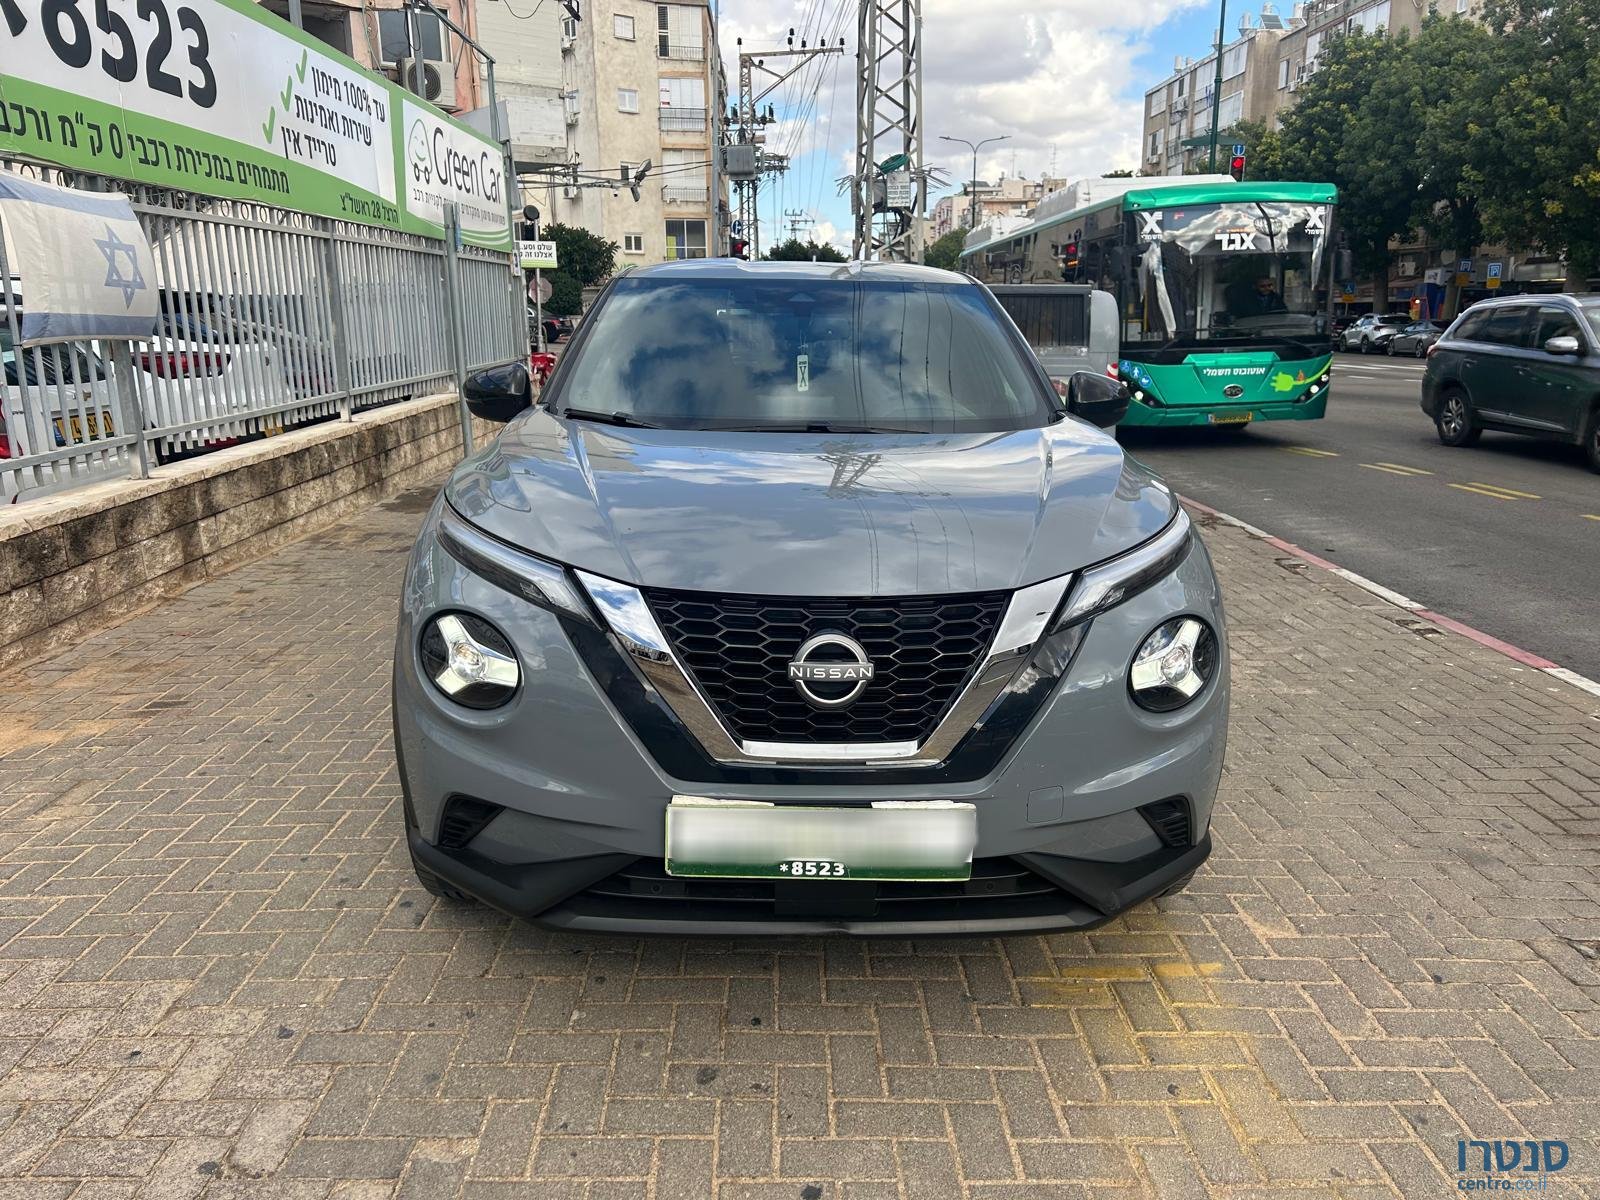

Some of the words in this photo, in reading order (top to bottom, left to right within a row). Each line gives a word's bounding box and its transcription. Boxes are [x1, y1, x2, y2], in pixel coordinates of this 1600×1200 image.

[312, 67, 342, 101] מימון
[344, 80, 372, 116] 100%
[294, 94, 340, 134] ואמינות
[373, 99, 385, 122] עד
[109, 123, 123, 159] 0
[281, 126, 302, 159] אין
[342, 115, 372, 147] שירות
[127, 133, 171, 169] רכבי
[174, 144, 234, 183] במכירת
[304, 134, 336, 166] טרייד
[433, 126, 479, 196] Green
[481, 151, 501, 204] Car
[236, 160, 290, 194] מתמחים
[371, 200, 381, 219] 28
[381, 202, 399, 223] הרצל
[534, 250, 553, 258] אצלנו
[537, 243, 552, 251] שלם
[1203, 368, 1231, 376] חשמלי
[1233, 367, 1266, 375] אוטובוס
[789, 665, 873, 679] NISSAN
